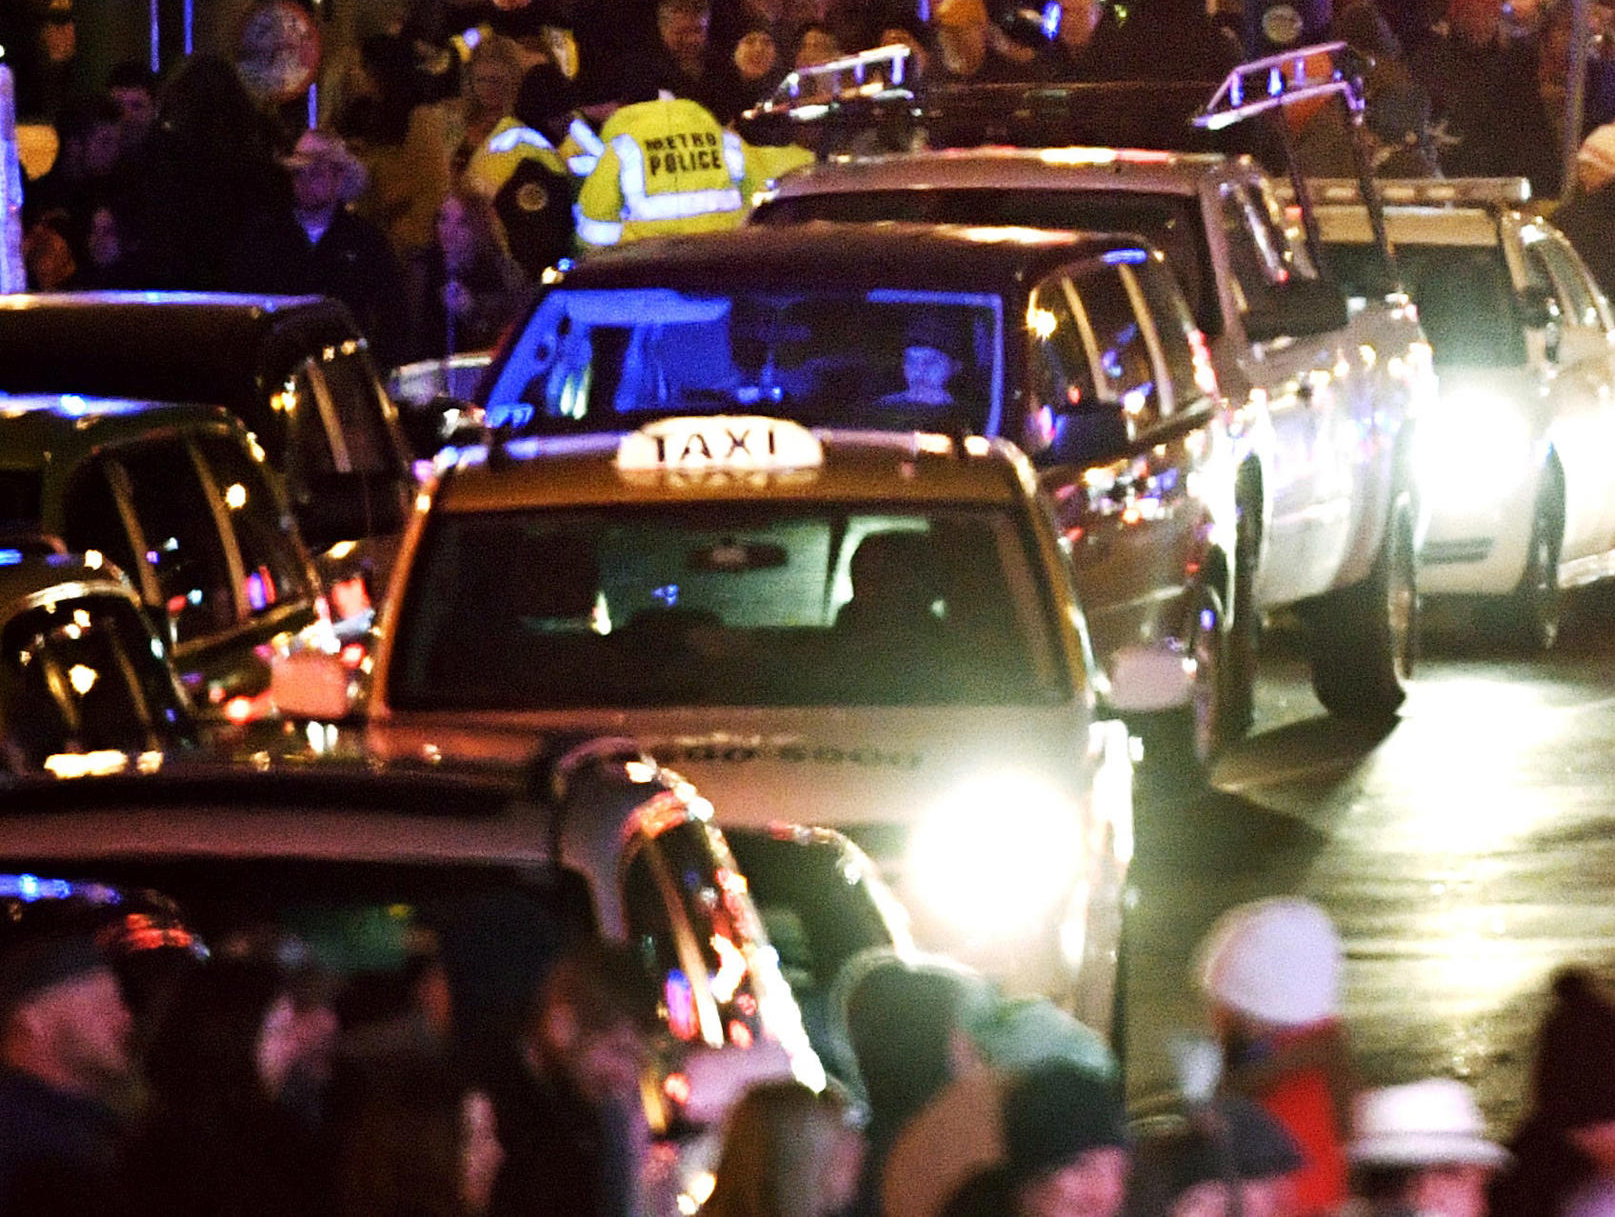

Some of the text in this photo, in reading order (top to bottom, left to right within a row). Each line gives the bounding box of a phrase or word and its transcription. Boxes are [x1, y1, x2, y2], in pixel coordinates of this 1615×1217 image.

[644, 132, 717, 153] METRO
[650, 149, 722, 176] POLICE
[652, 428, 776, 464] TAXI
